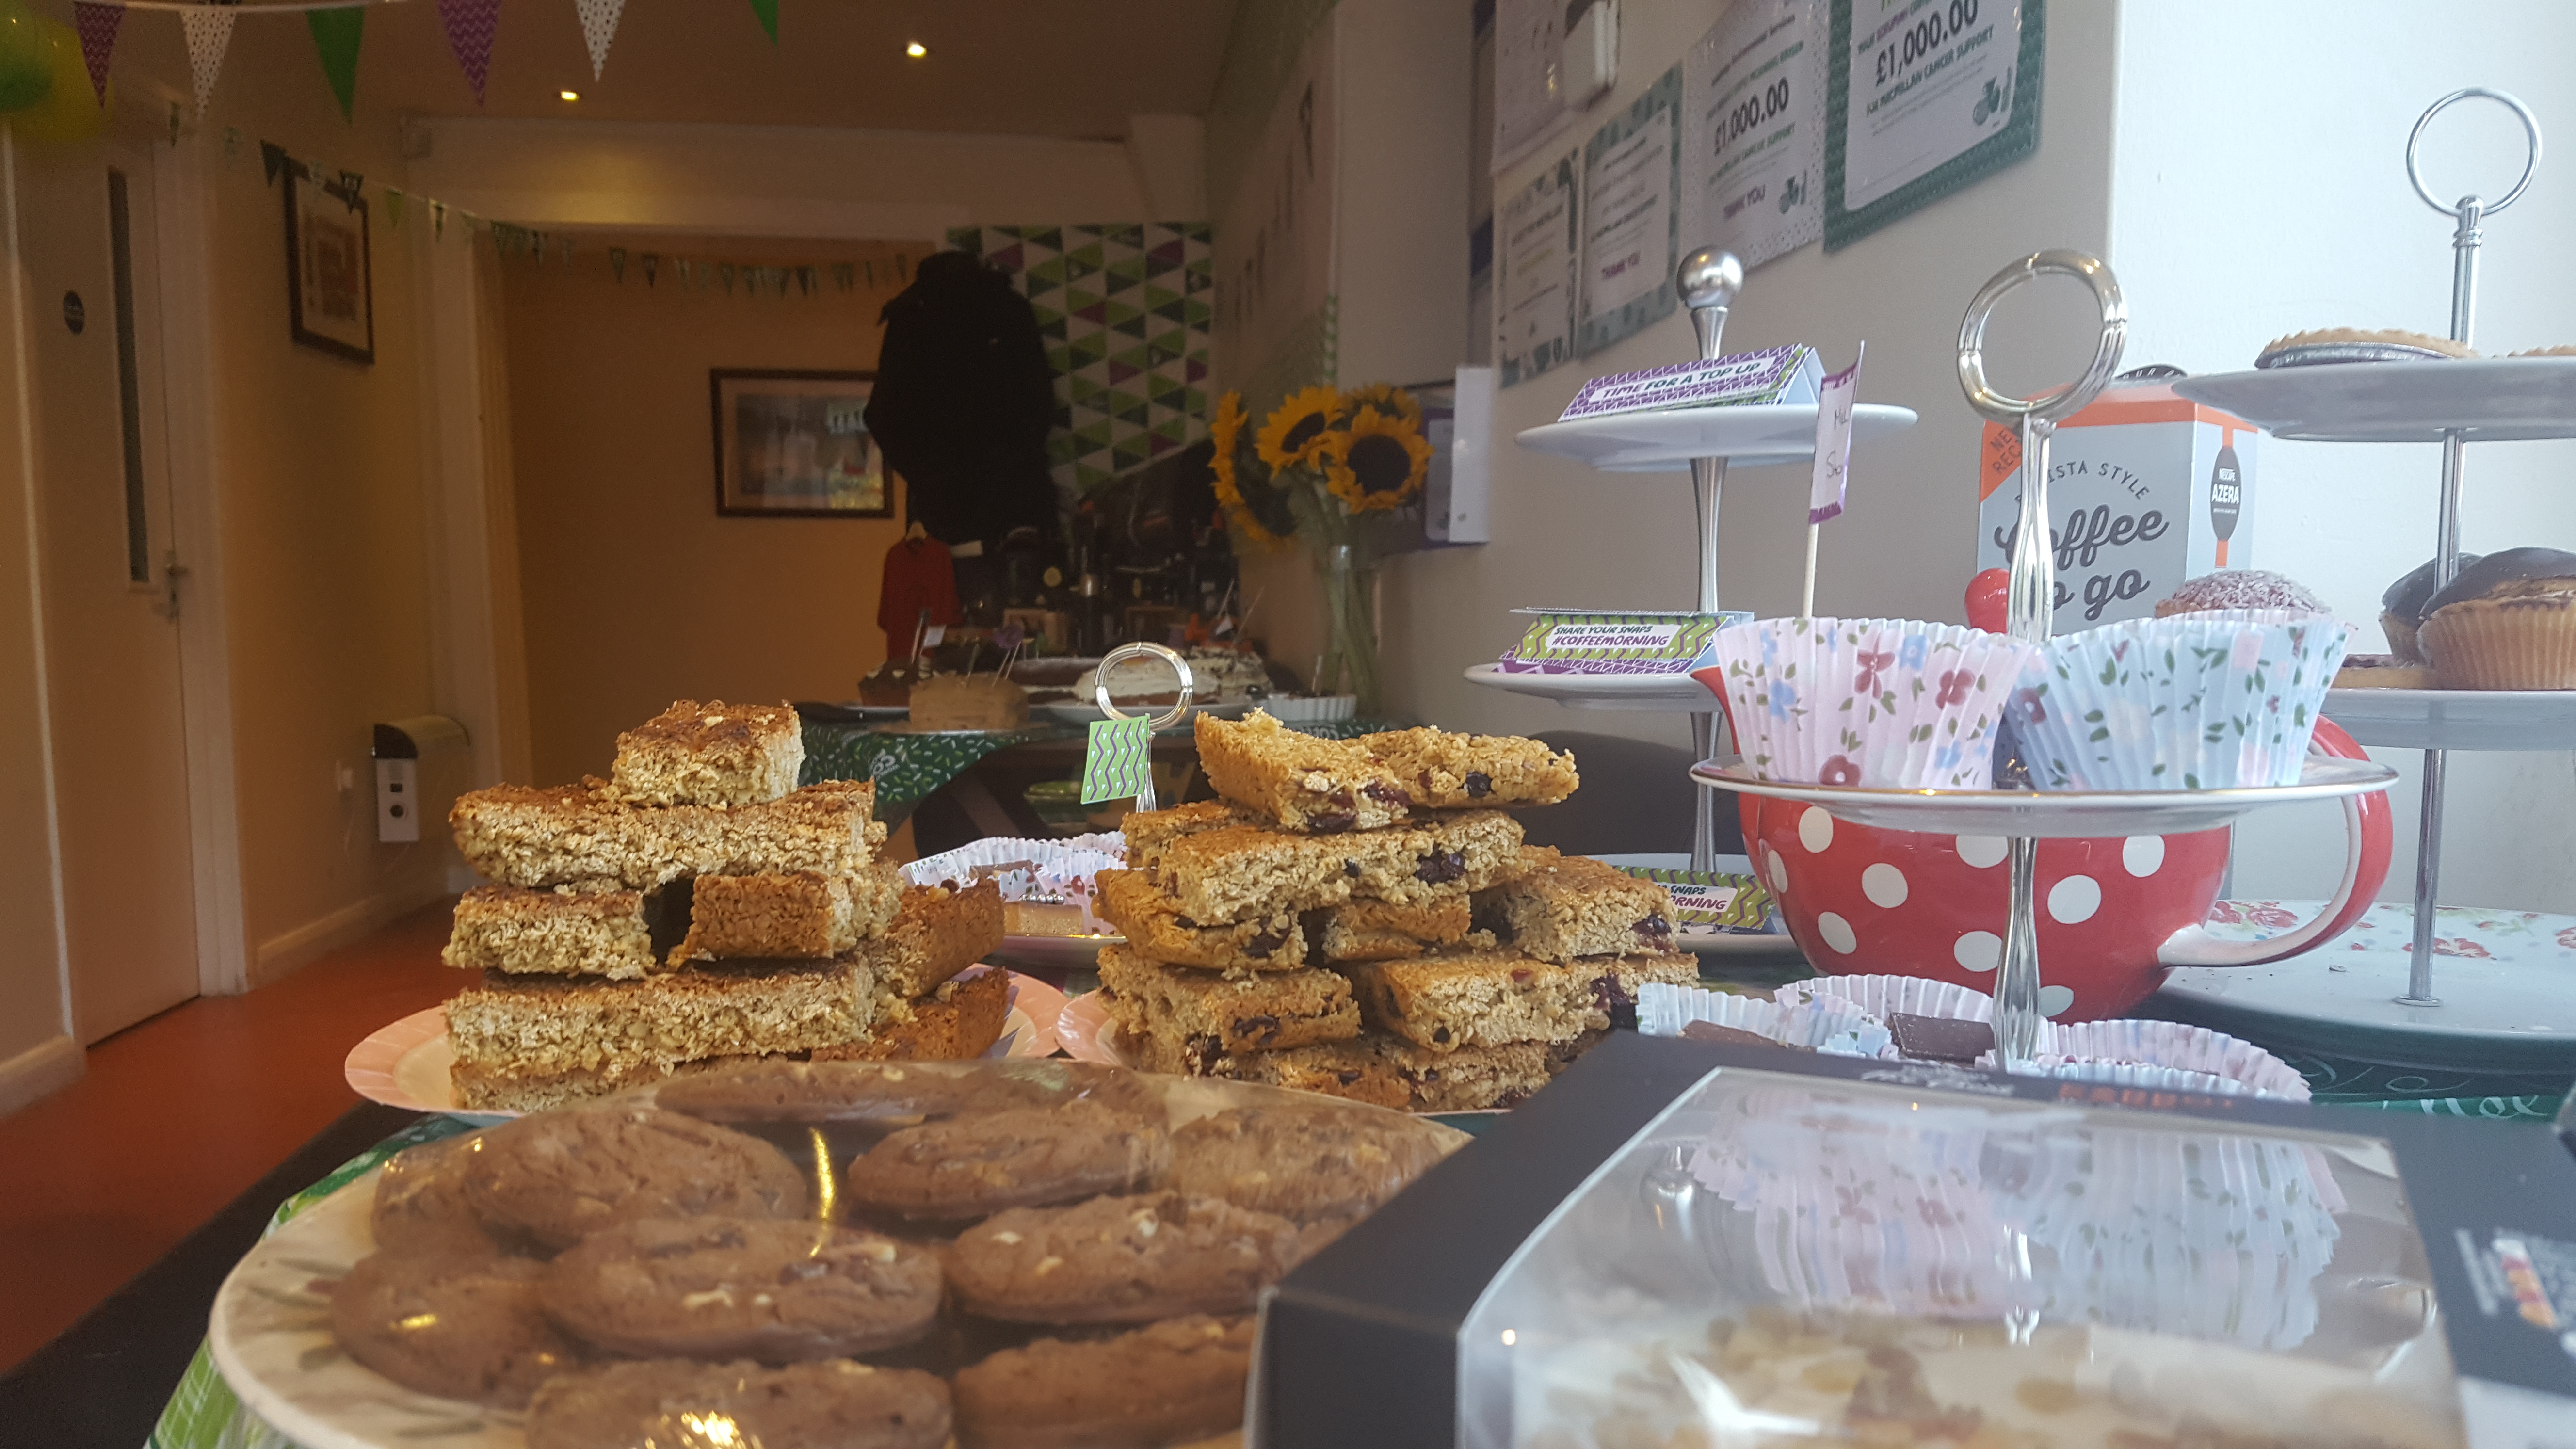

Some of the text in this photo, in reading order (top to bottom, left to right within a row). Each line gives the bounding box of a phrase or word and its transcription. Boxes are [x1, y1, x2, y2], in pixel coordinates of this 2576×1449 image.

[1876, 0, 1978, 87] £1,000.00
[1956, 24, 1994, 61] SUPPORT
[1603, 362, 1761, 398] TIME FOR A TOP UP
[2098, 463, 2150, 500] STYLE
[2211, 483, 2239, 504] AZERA
[2084, 569, 2151, 621] go
[1554, 625, 1653, 635] SHARE YOUR SNAPS
[1671, 885, 1707, 895] SNAPS
